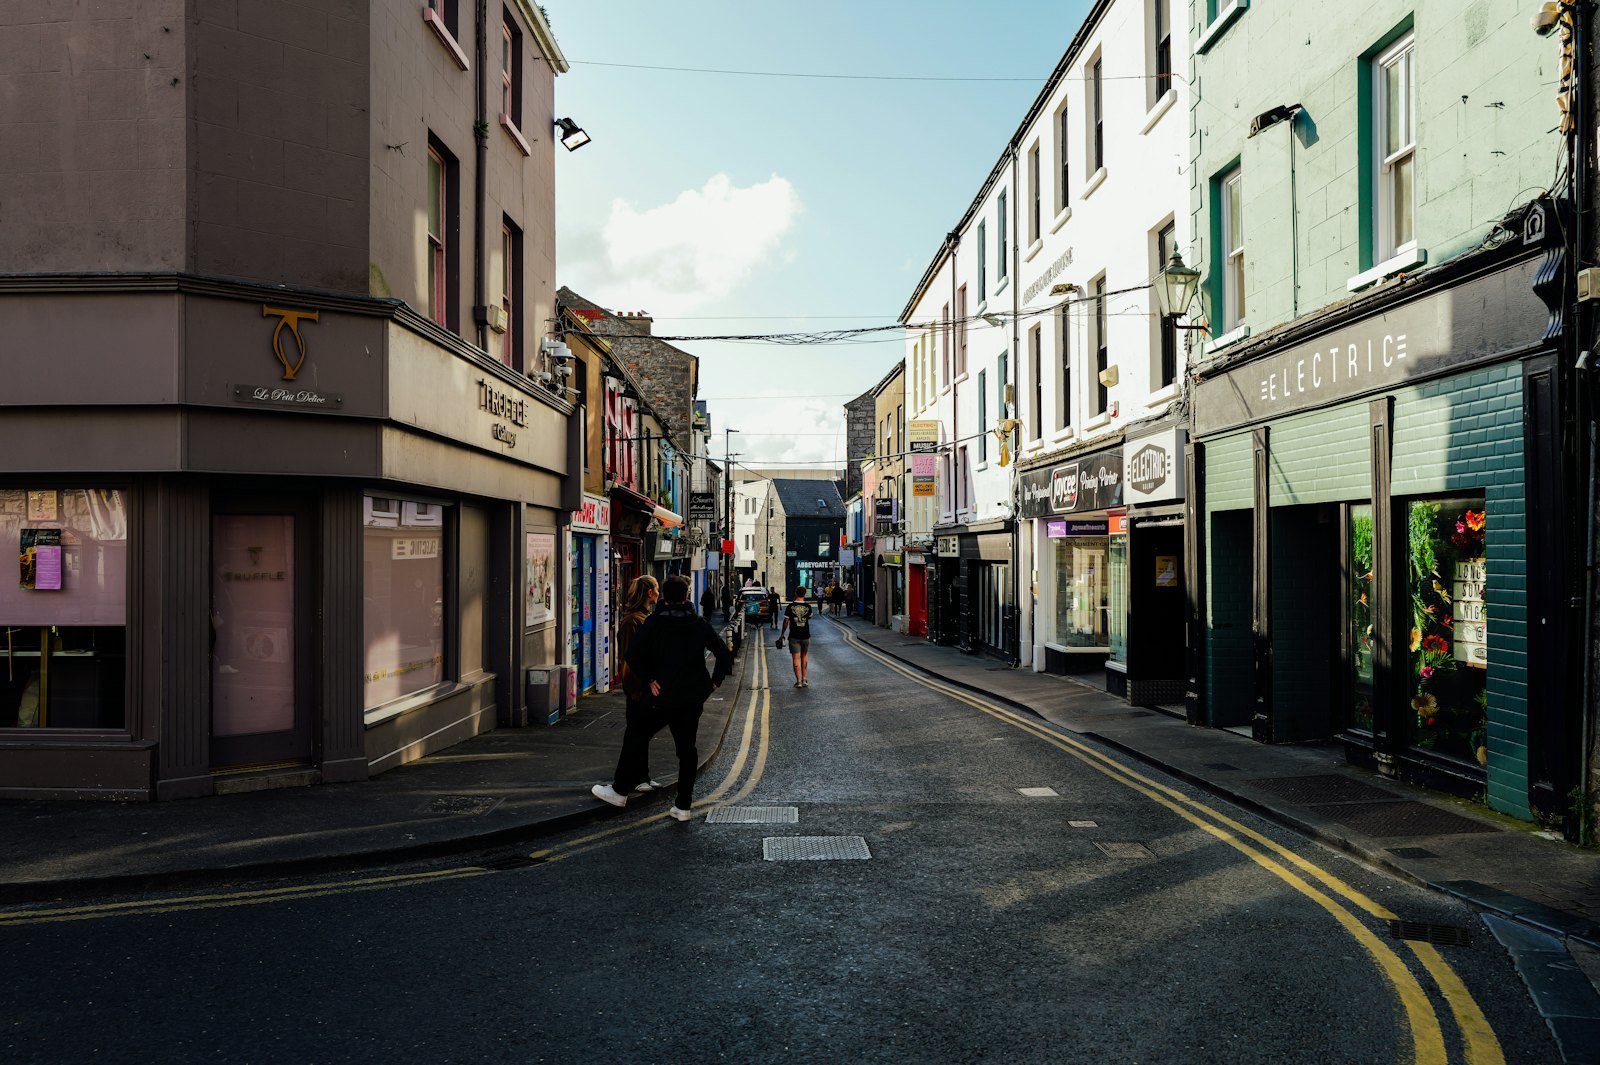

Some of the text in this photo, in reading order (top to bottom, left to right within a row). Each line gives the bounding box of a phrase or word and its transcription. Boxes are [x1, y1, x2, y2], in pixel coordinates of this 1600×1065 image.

[1269, 335, 1393, 401] ELECTRIC
[252, 387, 326, 404] Le Petit Delice
[477, 378, 529, 429] TRUFFLE
[1132, 449, 1165, 483] ELECTRIC
[1080, 466, 1118, 494] Printing Partner
[796, 561, 828, 569] ABBEYGATE
[1458, 564, 1481, 580] LONG
[1462, 583, 1481, 597] SUM
